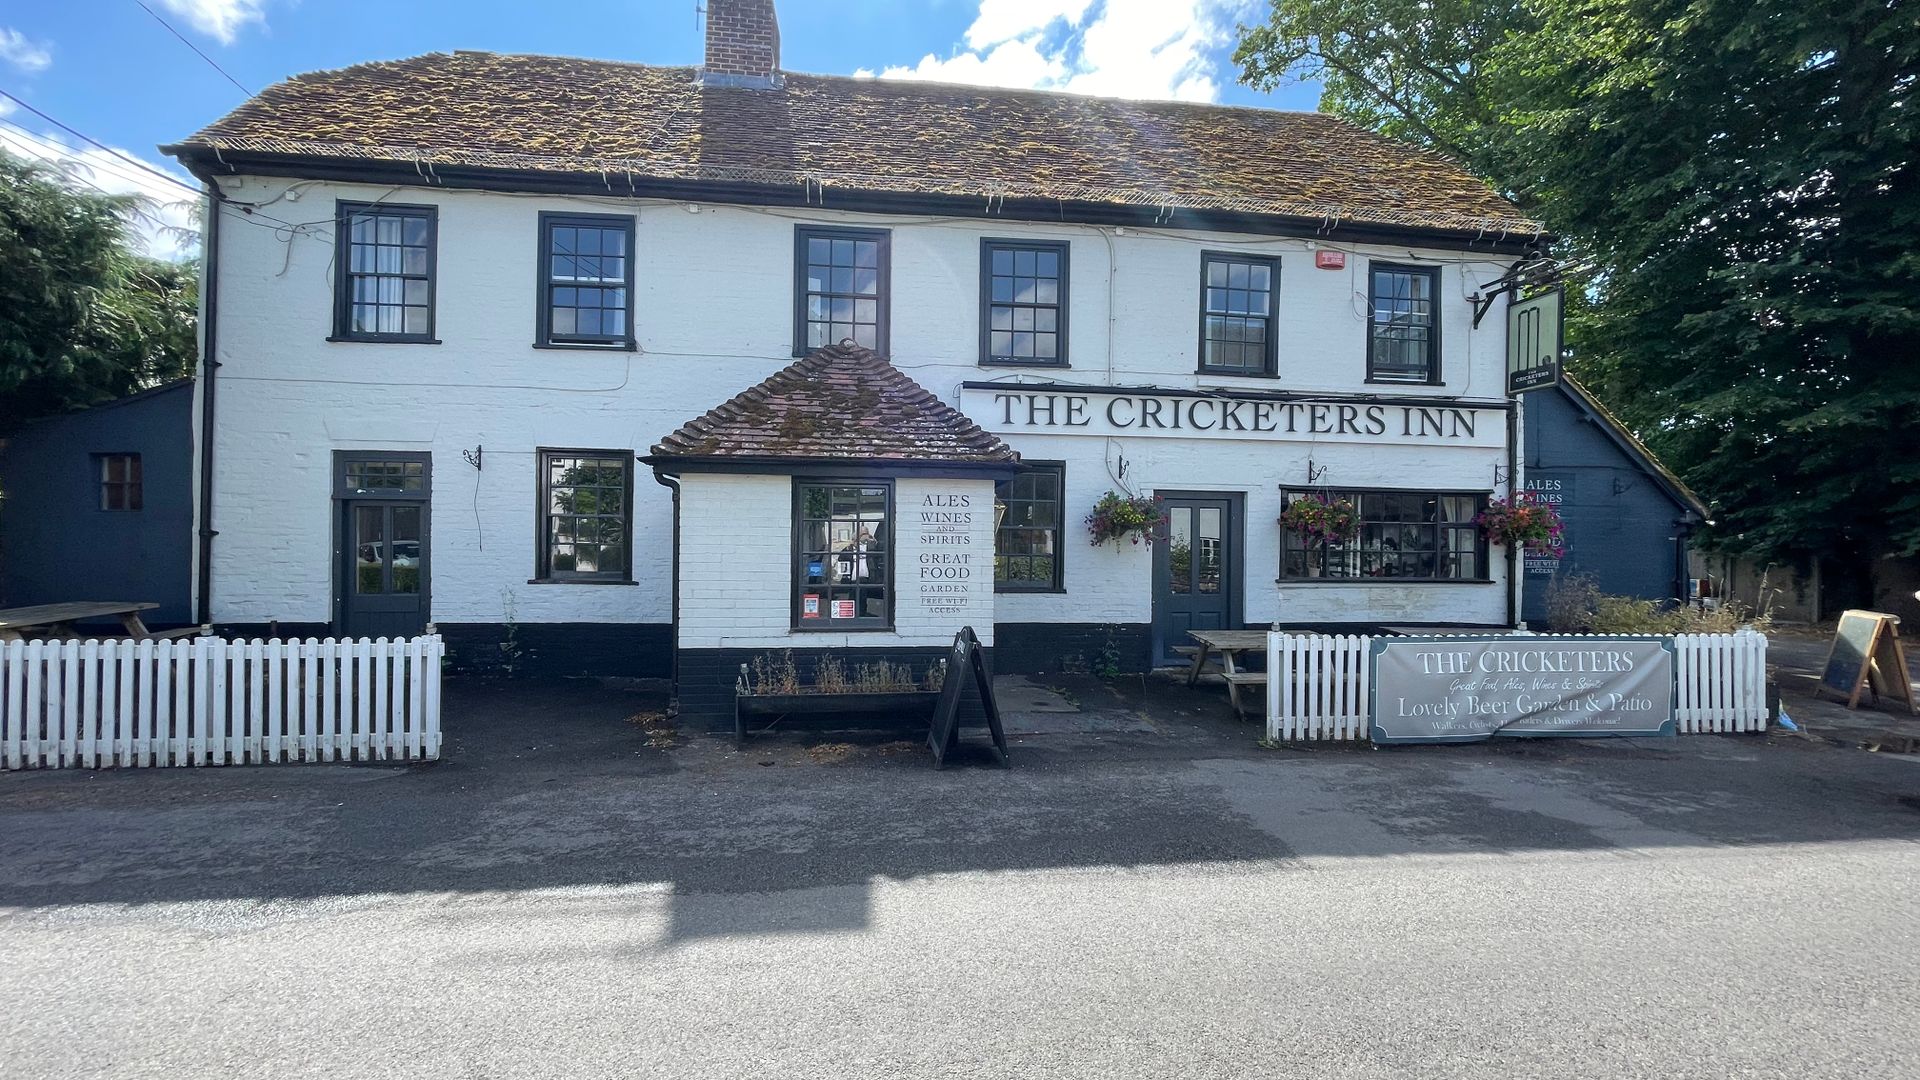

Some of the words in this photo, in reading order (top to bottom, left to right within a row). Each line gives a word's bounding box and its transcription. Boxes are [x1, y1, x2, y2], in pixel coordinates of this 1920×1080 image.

[994, 393, 1092, 427] THE
[1105, 396, 1387, 436] CRICKETERS
[1400, 407, 1479, 439] INN
[1526, 480, 1562, 491] ALES
[922, 494, 971, 508] ALES
[920, 512, 972, 524] WINES
[920, 535, 971, 545] SPIRITS
[919, 553, 971, 564] GREAT
[920, 567, 971, 579] FOOD
[920, 585, 968, 593] GARDEN
[928, 606, 961, 614] ACCESS
[1416, 651, 1473, 675] THE
[1479, 650, 1634, 674] CRICKETERS
[1449, 678, 1476, 695] Great
[1503, 677, 1526, 693] Ales,
[1532, 677, 1557, 691] Wines
[1561, 677, 1572, 691] &
[1397, 696, 1461, 720] Lovely
[1466, 695, 1510, 715] Beer
[1585, 693, 1603, 712] &
[1608, 692, 1653, 712] Patio
